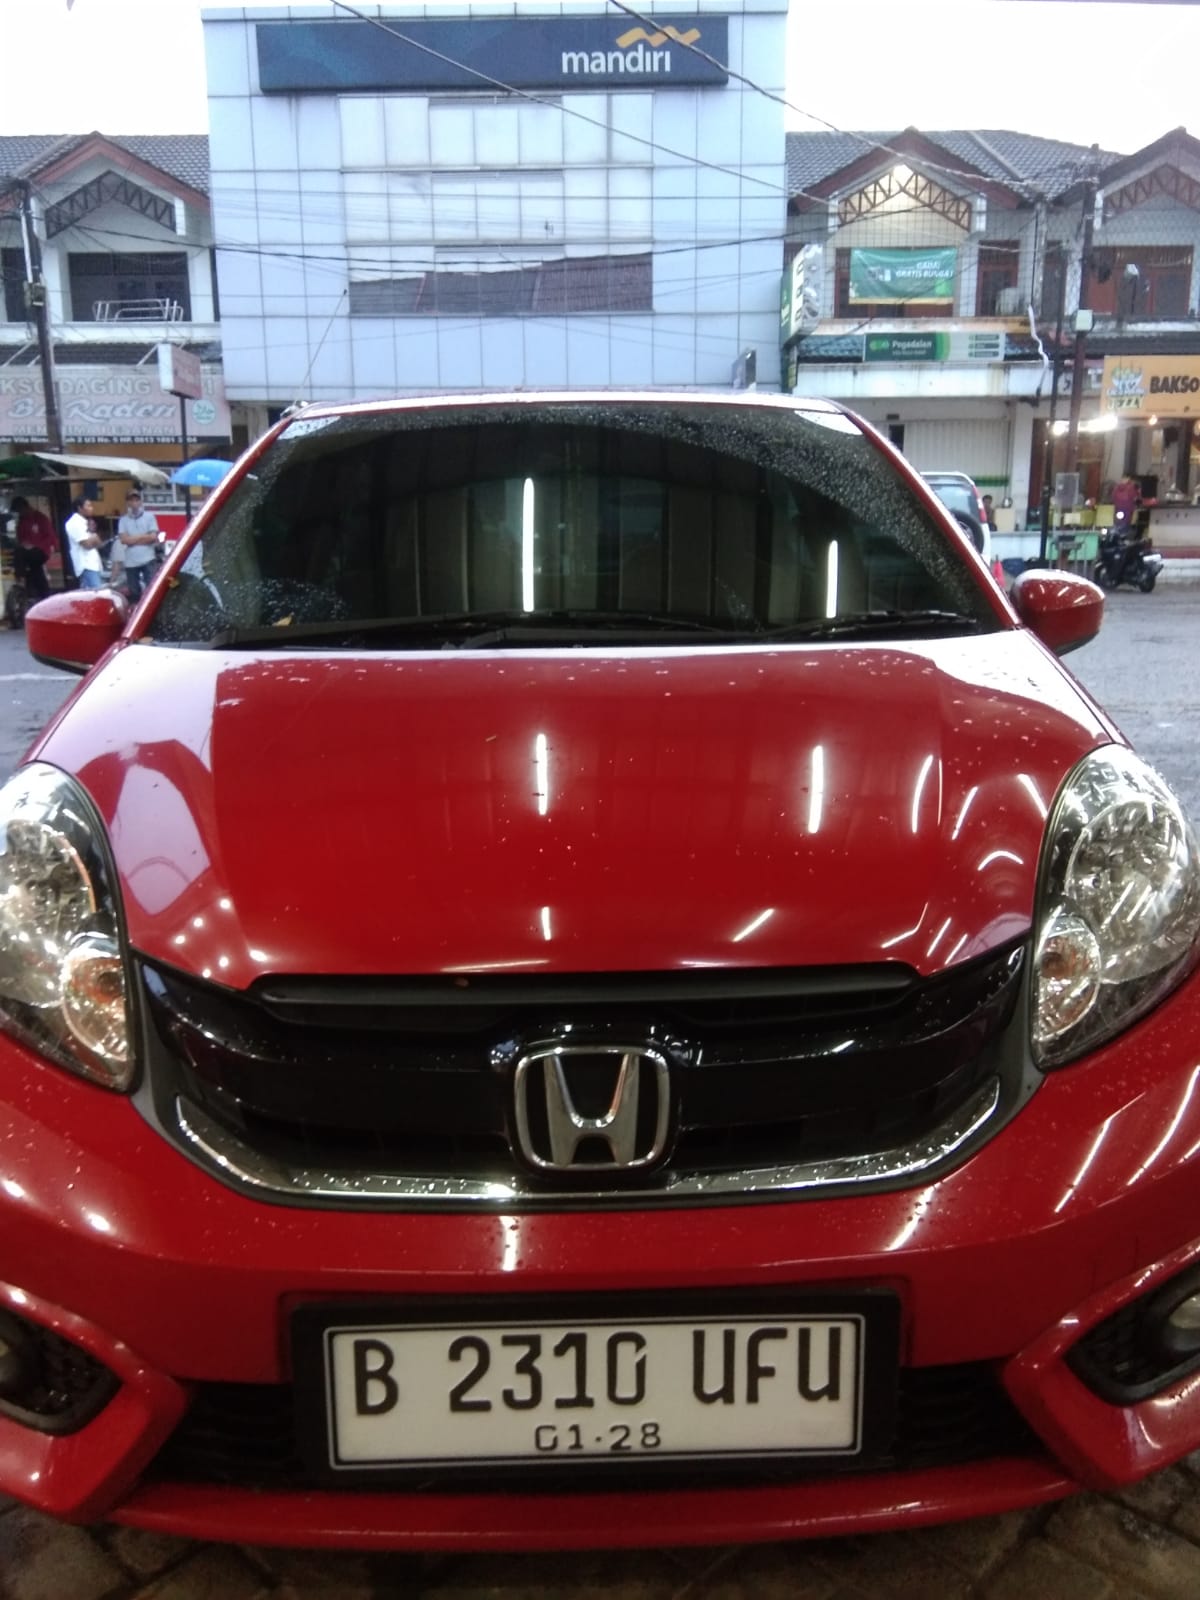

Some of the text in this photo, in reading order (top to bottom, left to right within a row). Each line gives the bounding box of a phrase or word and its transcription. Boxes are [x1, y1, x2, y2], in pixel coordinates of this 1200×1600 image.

[561, 43, 671, 74] mandiri
[60, 378, 151, 395] DAGING
[1149, 375, 1200, 394] BAKSO
[353, 1326, 842, 1416] B 2310 UFU
